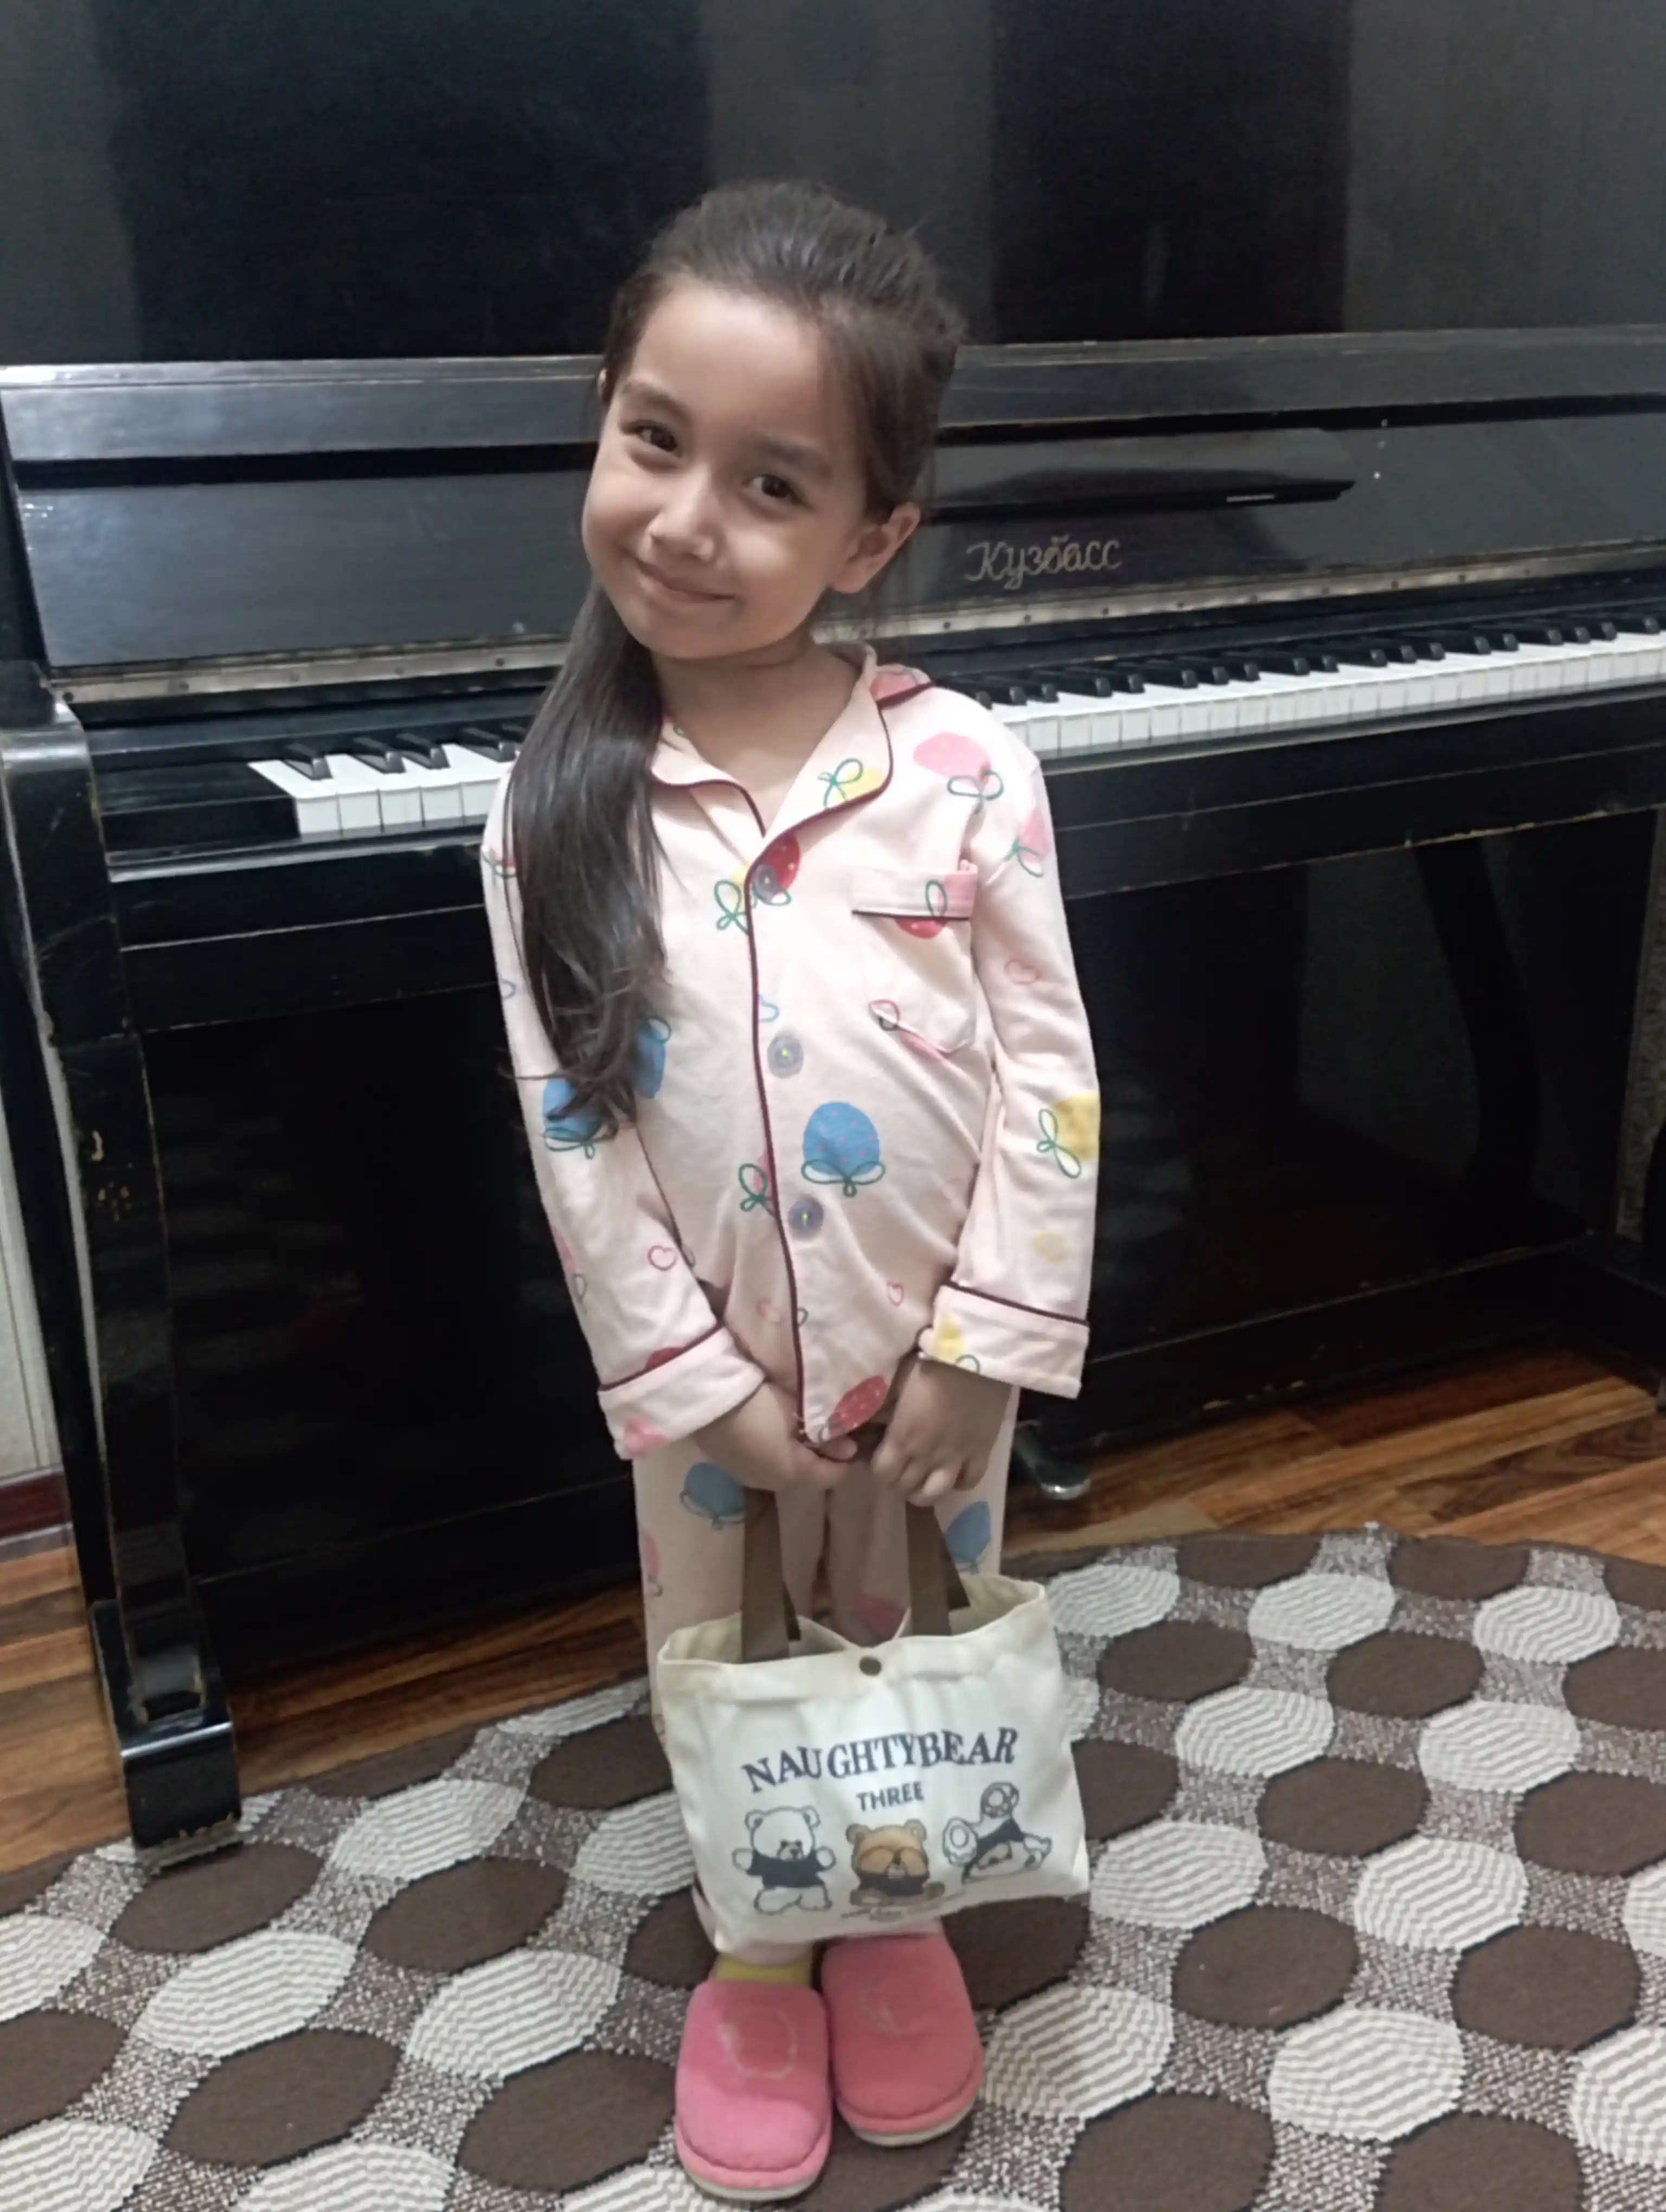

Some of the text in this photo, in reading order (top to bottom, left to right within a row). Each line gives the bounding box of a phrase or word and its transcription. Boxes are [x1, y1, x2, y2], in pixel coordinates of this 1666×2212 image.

[965, 534, 1123, 589] Кузбасс
[741, 1727, 1018, 1793] NAUGHTYBEAR
[856, 1782, 925, 1812] THREE
